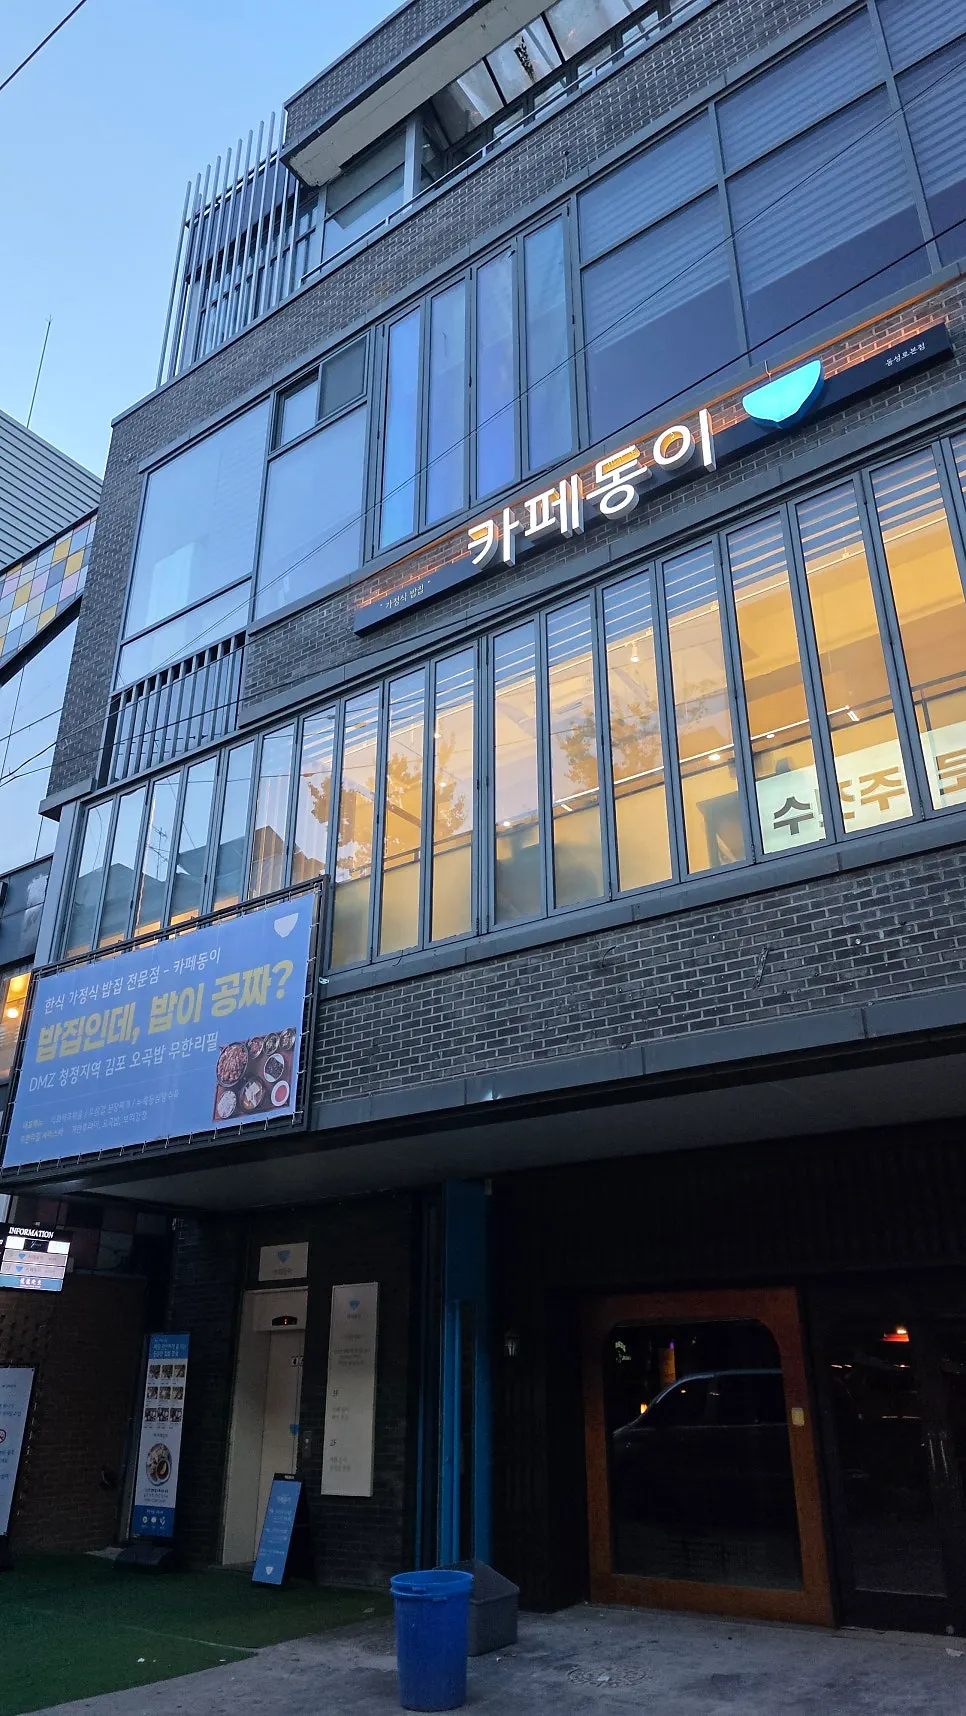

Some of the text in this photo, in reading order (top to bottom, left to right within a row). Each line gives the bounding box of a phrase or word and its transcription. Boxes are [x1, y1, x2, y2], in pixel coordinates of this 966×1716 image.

[467, 408, 716, 568] 카페동이
[35, 959, 295, 1063] 밥집인데, 밥이 공짜?
[44, 993, 65, 1015] 한식
[69, 984, 99, 1005] 가정식
[102, 976, 124, 998] 밥집
[127, 966, 160, 991] 전문점
[173, 947, 221, 975] 카페동이
[29, 1031, 219, 1092] DMZ 청정지역 김포 오곡밥 무한리필
[8, 1226, 54, 1239] INFORMATION
